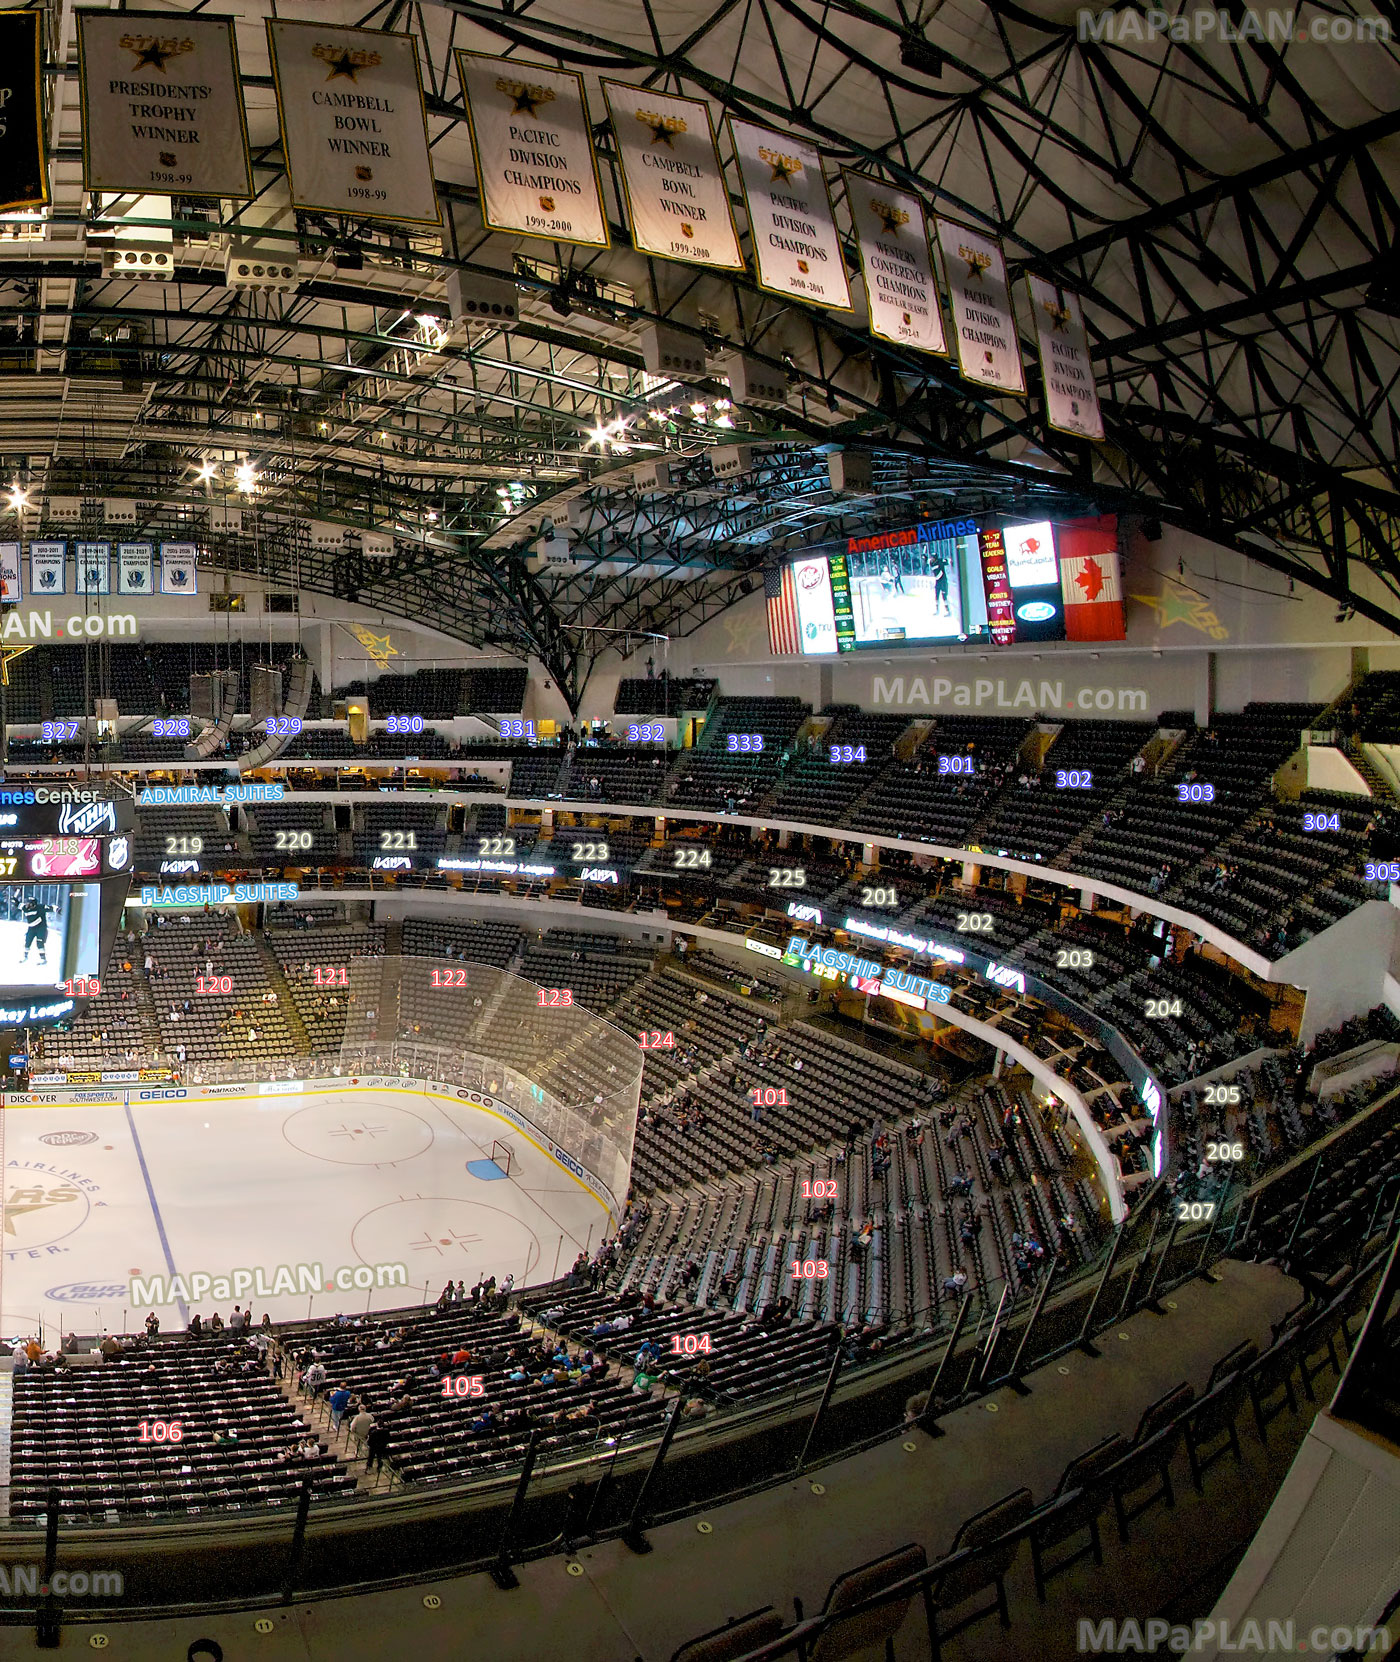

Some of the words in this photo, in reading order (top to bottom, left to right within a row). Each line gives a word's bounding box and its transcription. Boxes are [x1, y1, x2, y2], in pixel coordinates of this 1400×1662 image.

[312, 91, 394, 113] CAMPBELL
[129, 104, 196, 121] TROPHY
[335, 115, 382, 133] BOWL
[132, 125, 199, 143] WINNER
[509, 126, 560, 147] PACIFIC
[328, 138, 391, 157] WINNER
[509, 148, 567, 170] DIVISION
[642, 153, 703, 178] CAMPBELL
[150, 171, 192, 184] 1998-99
[504, 170, 582, 194] CHAMPIONS
[348, 187, 387, 200] 1998-99
[662, 178, 696, 198] BOWL
[660, 198, 707, 222] WINNER
[526, 216, 572, 232] 1999-2000
[10, 1095, 56, 1103] DISCOVER
[140, 1089, 187, 1099] GEICO
[555, 1149, 583, 1177] GEICO
[8, 1160, 100, 1192] AIRLINES
